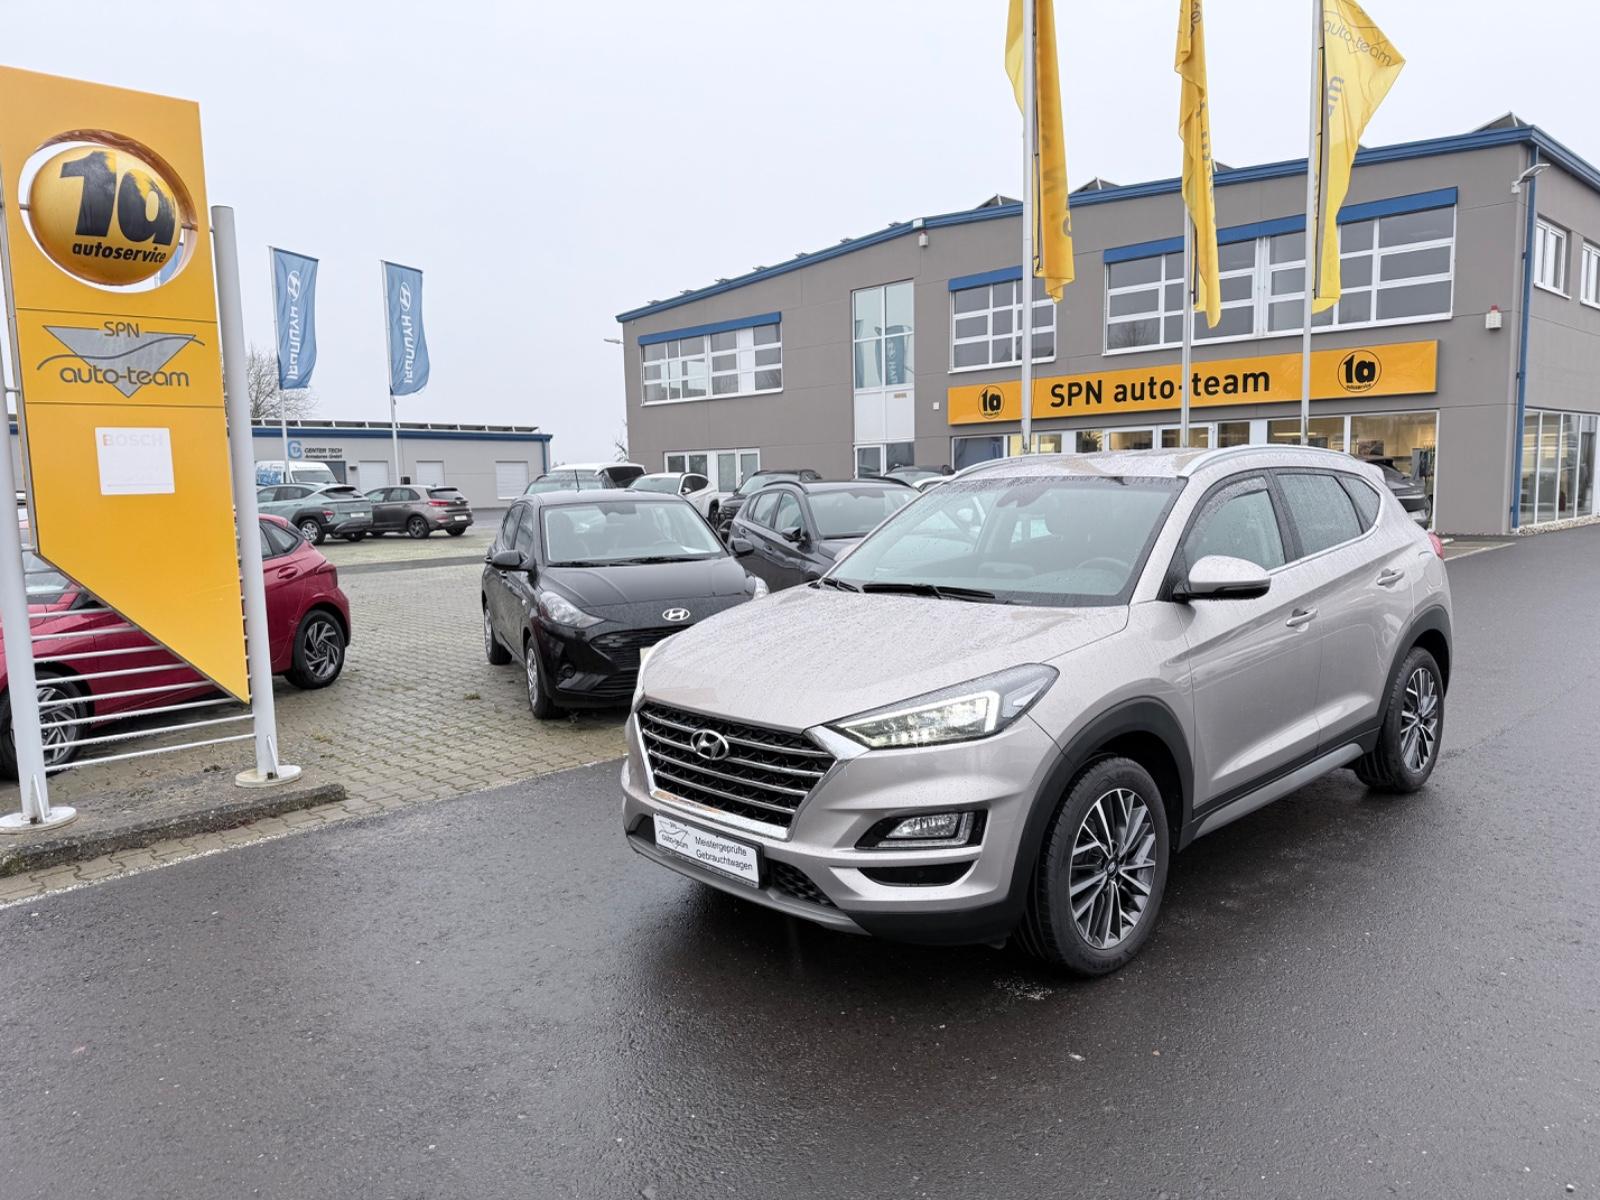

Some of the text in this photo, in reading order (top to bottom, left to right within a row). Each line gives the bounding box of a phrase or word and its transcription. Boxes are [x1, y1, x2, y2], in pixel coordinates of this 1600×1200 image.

[72, 241, 167, 264] autoservice
[104, 320, 140, 338] SPN
[285, 305, 300, 380] HYUNDAI
[400, 314, 416, 384] HYUNDAI
[60, 365, 190, 387] auto-team
[1343, 354, 1376, 384] 1a
[981, 389, 1002, 412] 1a
[1050, 379, 1103, 408] SPN
[103, 433, 164, 447] BOSCH
[695, 848, 753, 872] Gebrauchtwagen
